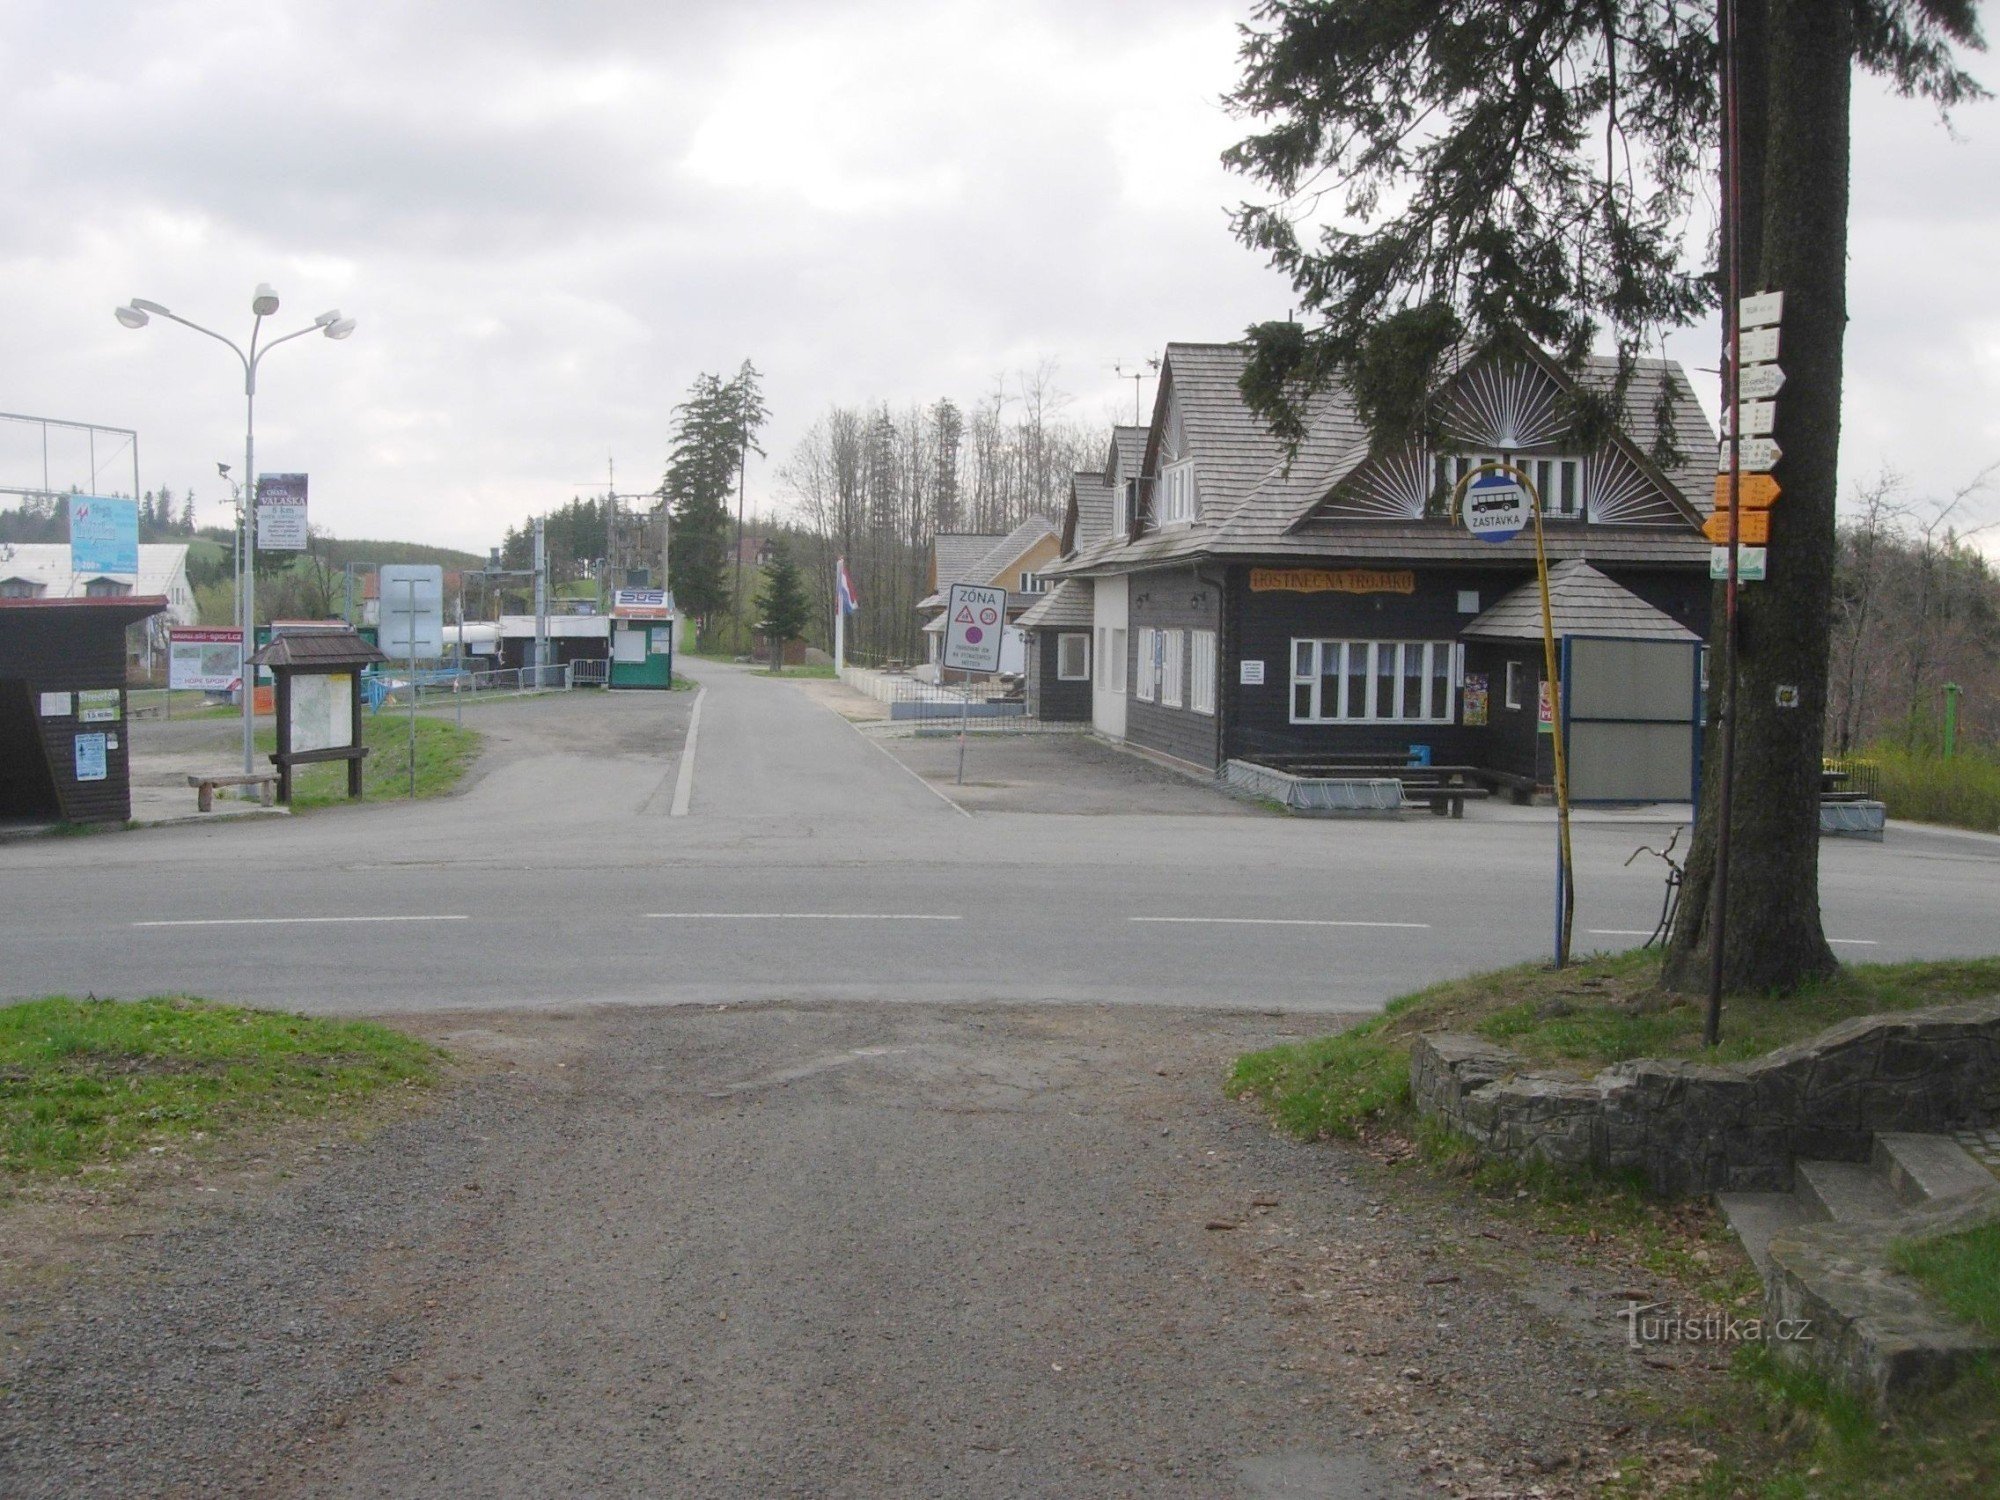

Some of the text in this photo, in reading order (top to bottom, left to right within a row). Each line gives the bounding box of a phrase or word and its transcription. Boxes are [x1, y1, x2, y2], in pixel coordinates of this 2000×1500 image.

[261, 495, 306, 506] VALAŠKA
[1473, 513, 1520, 527] ZASTÁVKA
[960, 589, 996, 605] ZÓNA
